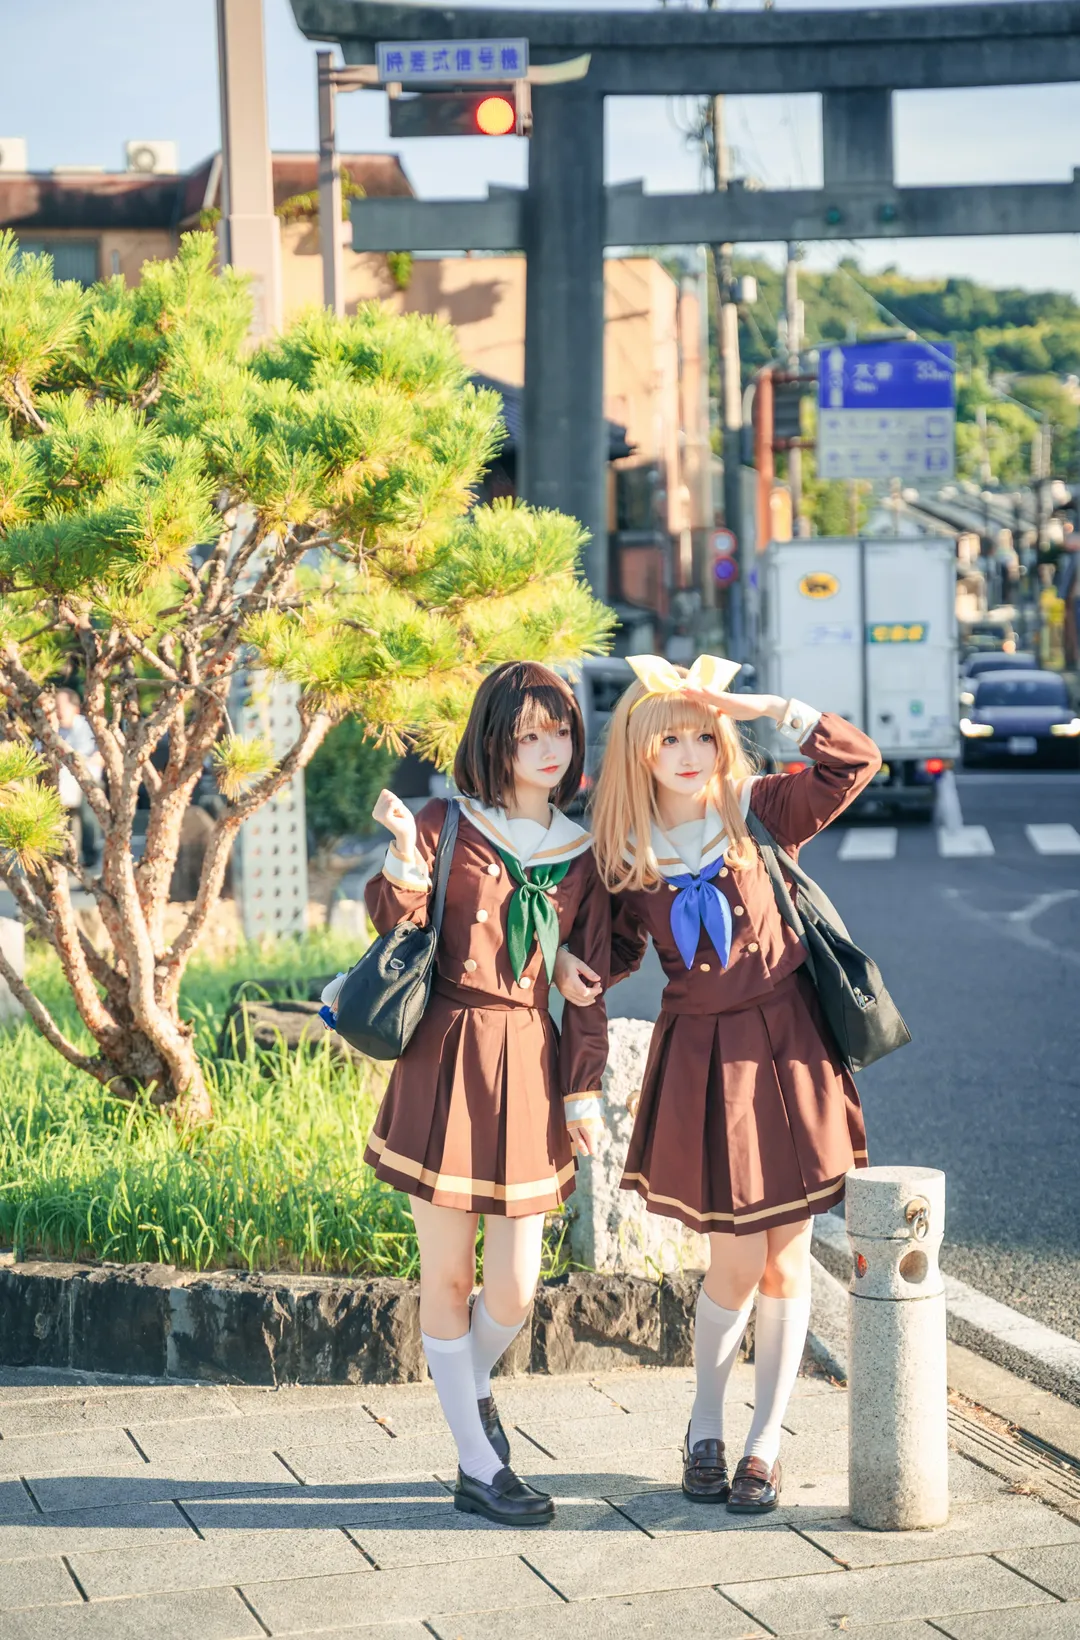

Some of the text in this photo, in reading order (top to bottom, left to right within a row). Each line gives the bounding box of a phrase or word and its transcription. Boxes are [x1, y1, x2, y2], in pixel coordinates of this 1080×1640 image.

[386, 46, 519, 73] 時差式信号機
